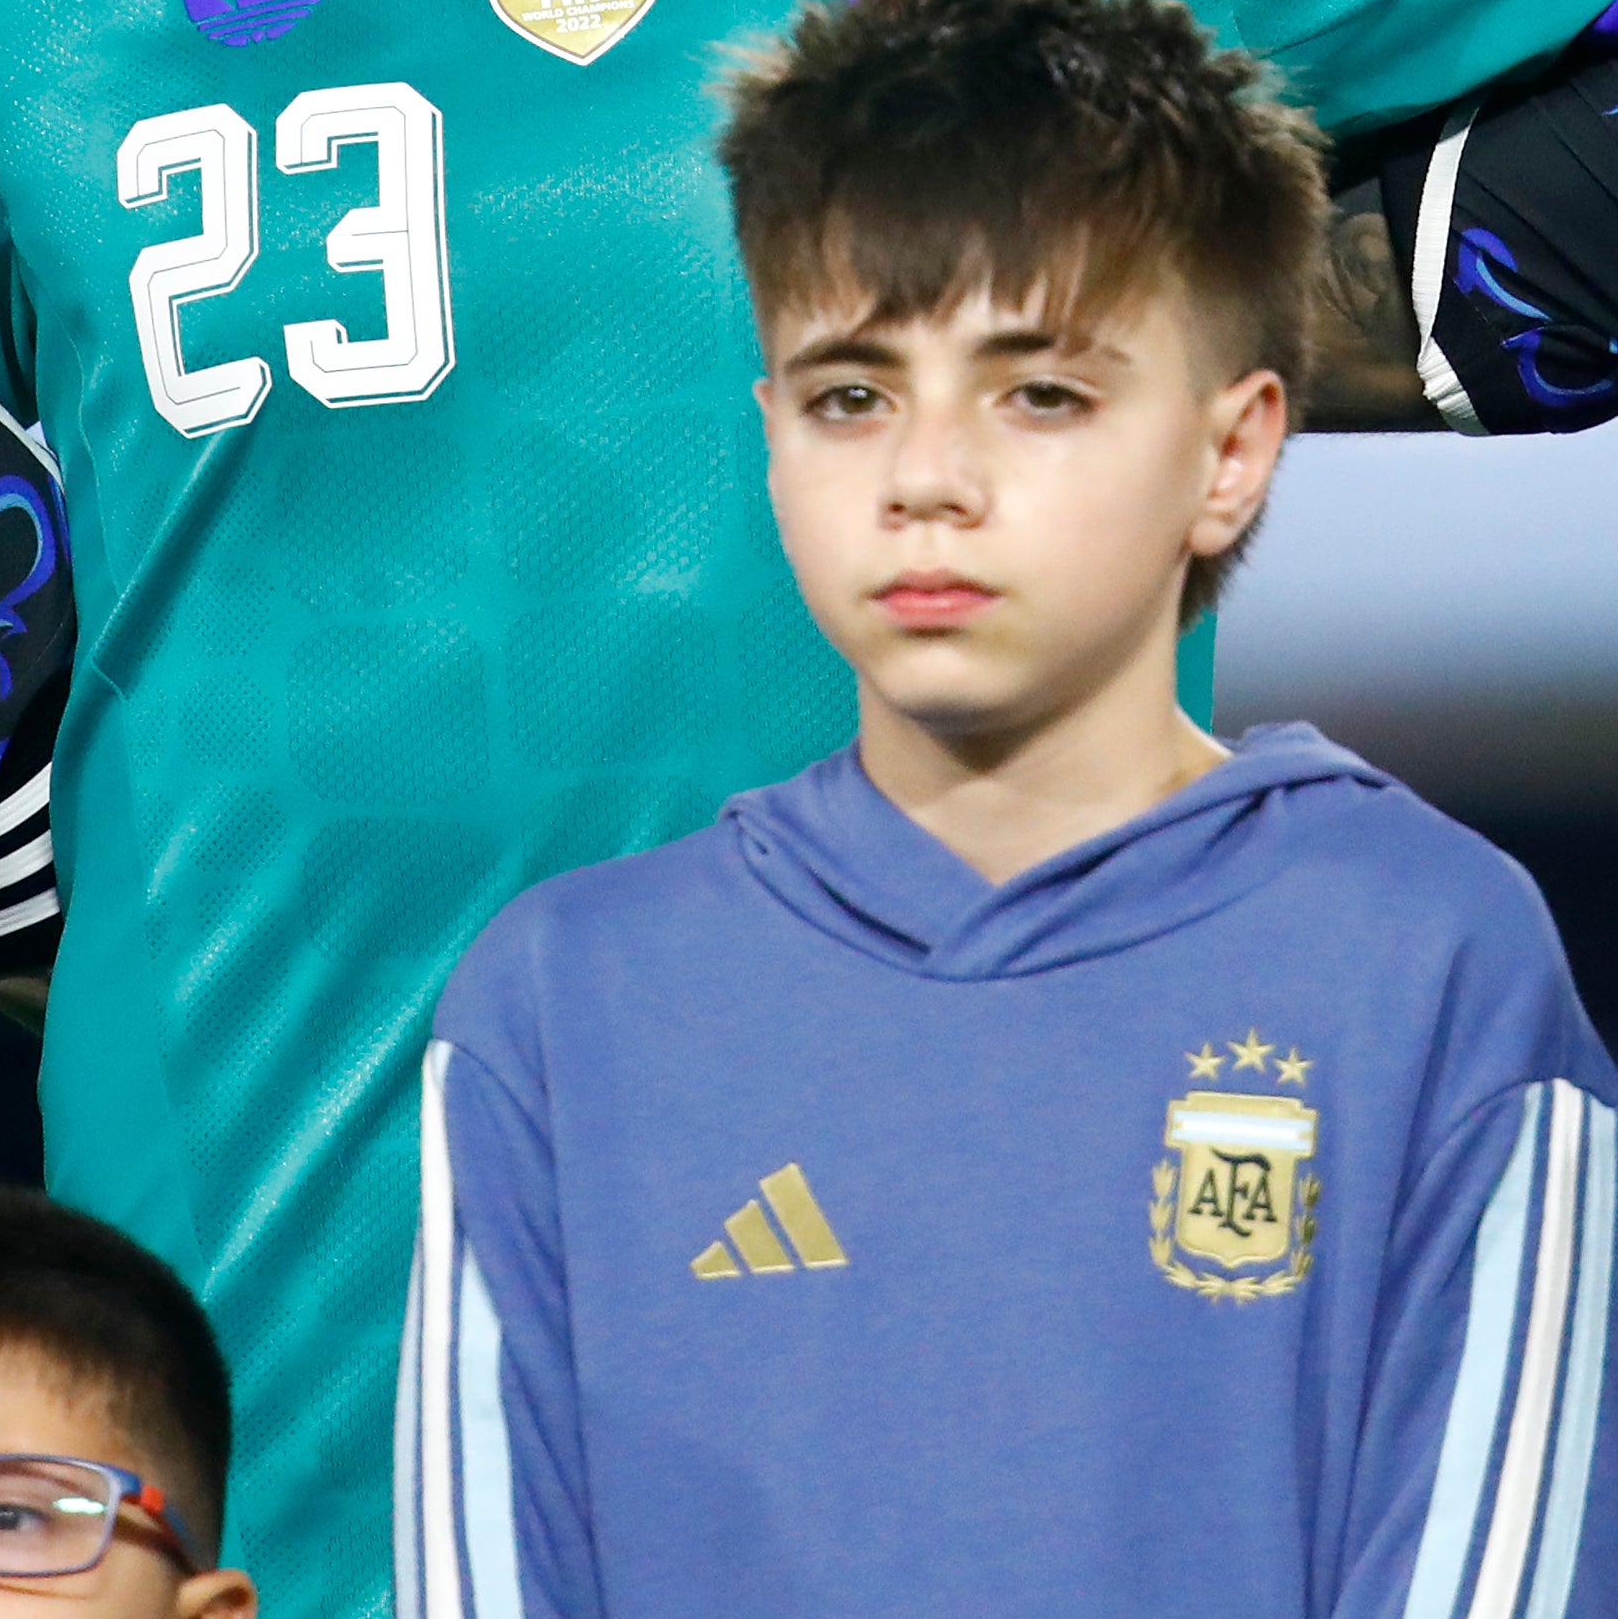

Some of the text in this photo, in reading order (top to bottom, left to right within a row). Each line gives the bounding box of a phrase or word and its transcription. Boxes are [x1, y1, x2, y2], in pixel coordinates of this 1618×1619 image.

[521, 0, 636, 22] WORLD CHAMPIONS
[556, 14, 602, 33] 2022
[116, 81, 456, 439] 23
[1187, 1147, 1278, 1237] AFA
